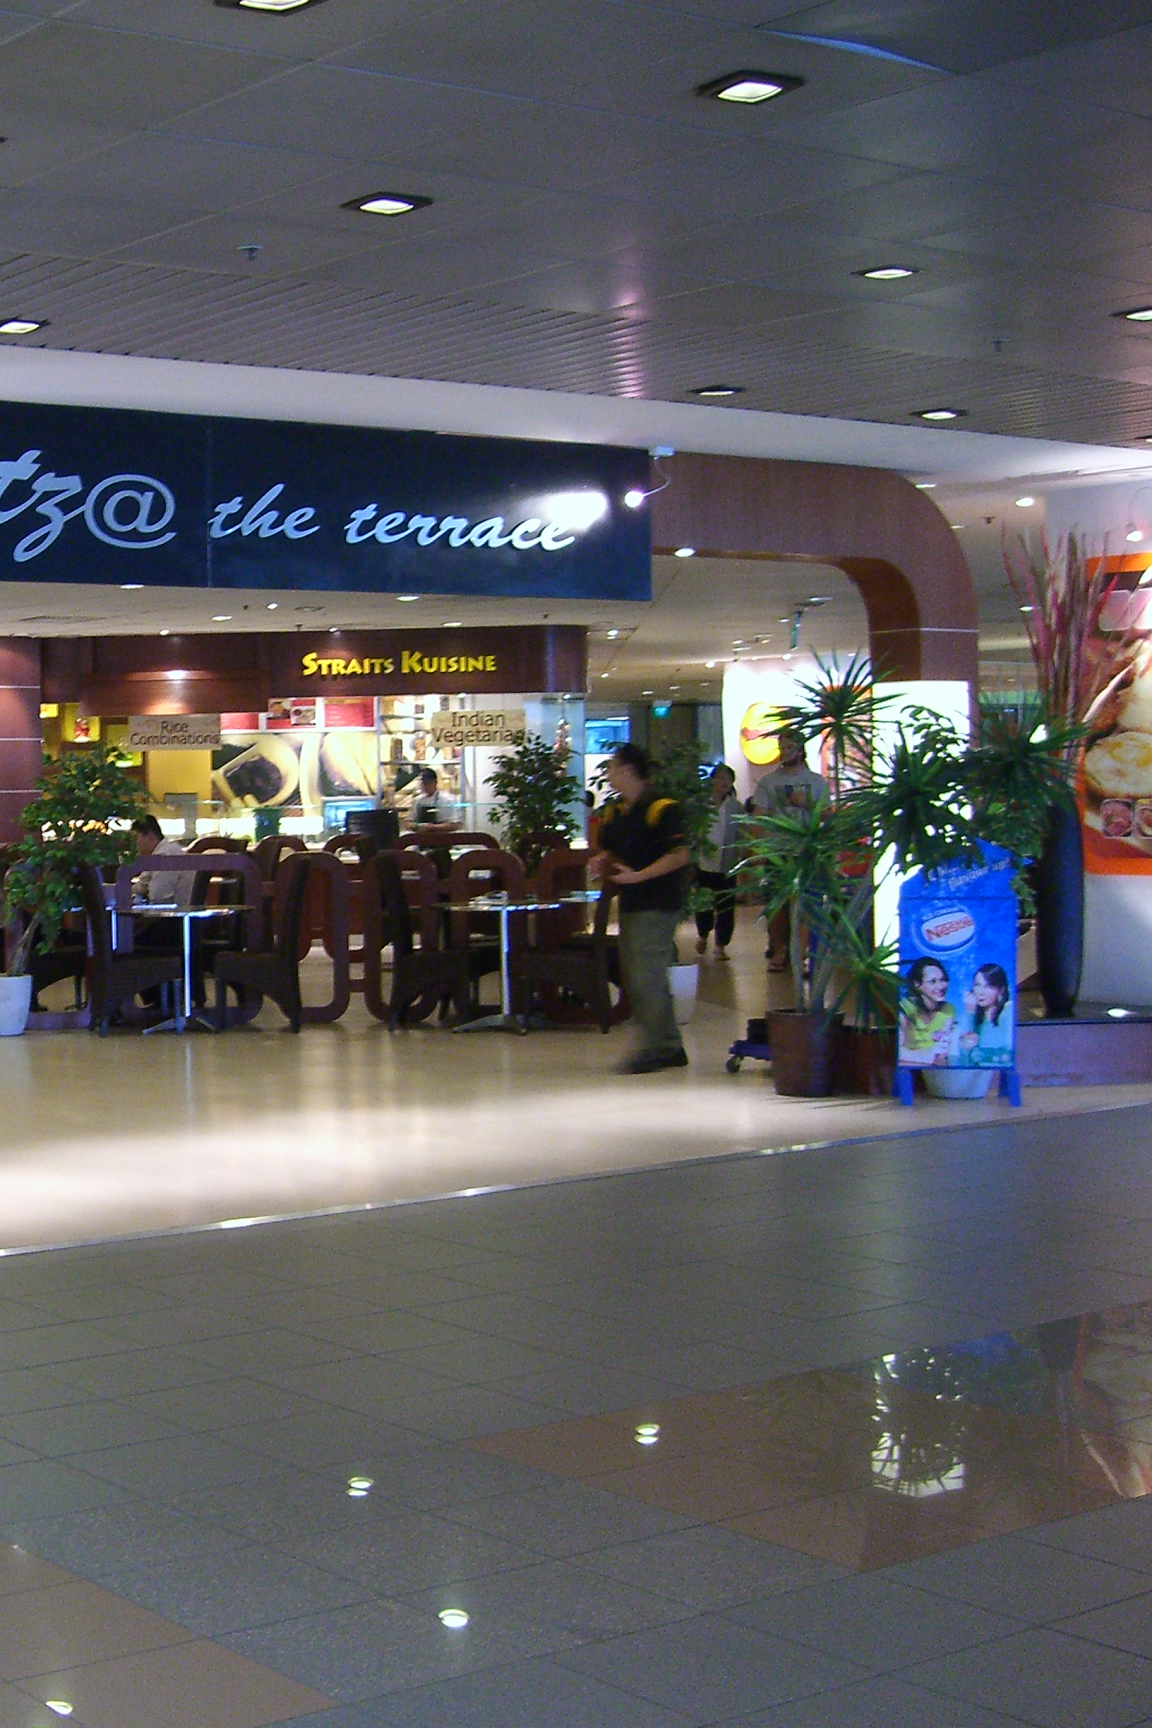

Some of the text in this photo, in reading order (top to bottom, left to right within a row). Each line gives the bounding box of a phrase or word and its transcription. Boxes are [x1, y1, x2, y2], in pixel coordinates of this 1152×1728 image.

[208, 482, 320, 540] the
[344, 502, 576, 551] terrace
[160, 720, 189, 733] Rice
[452, 711, 506, 727] Indian
[129, 732, 220, 746] Combinations
